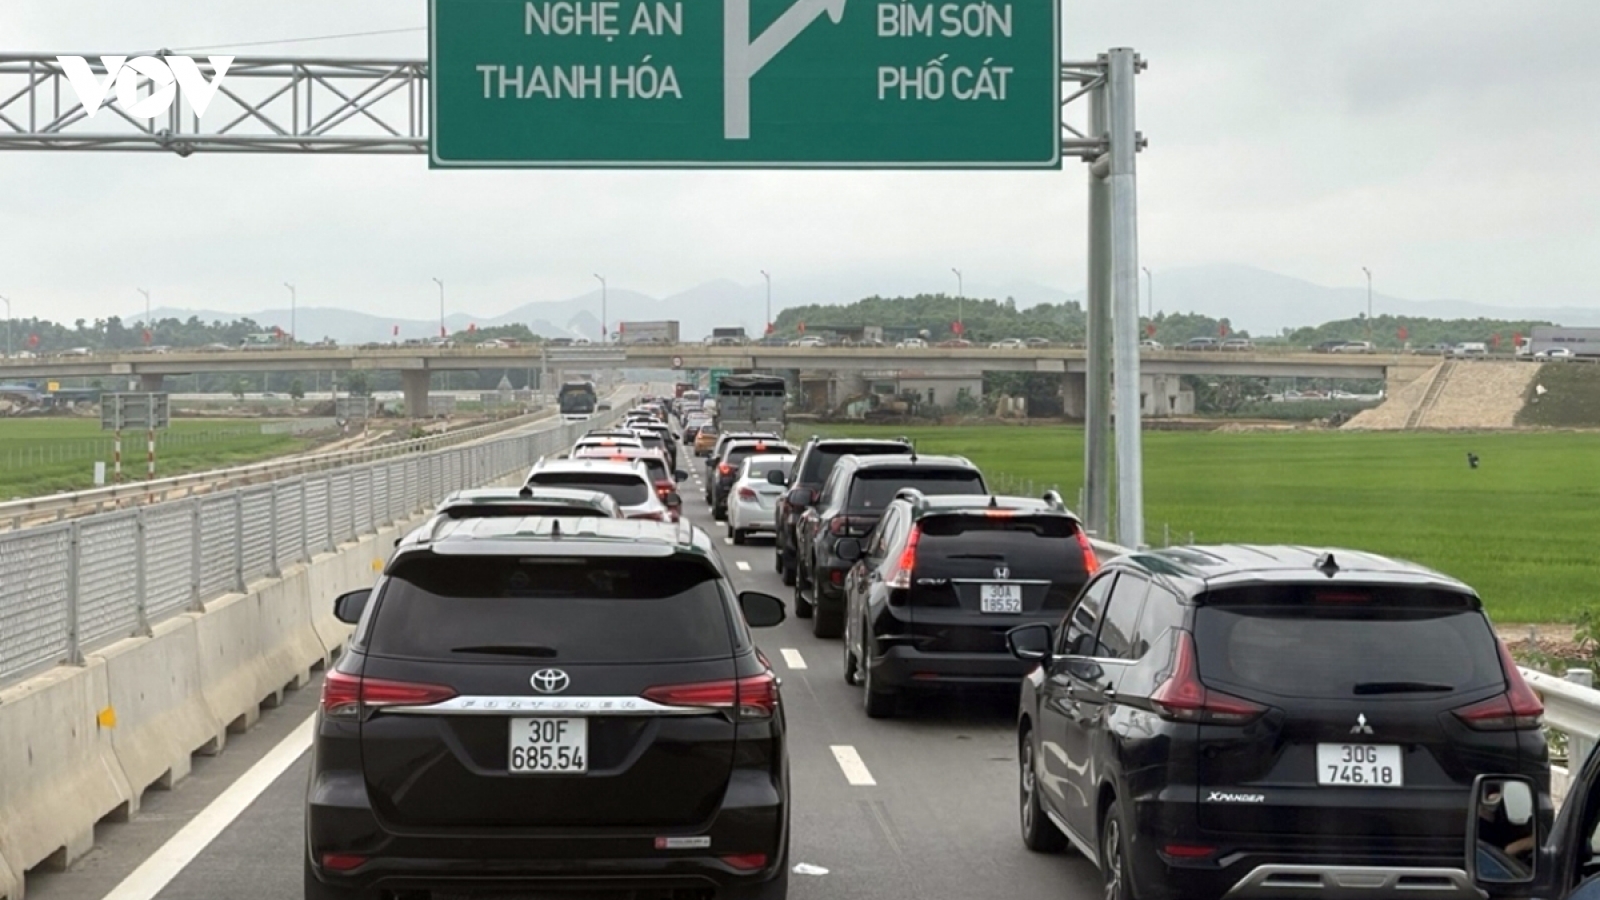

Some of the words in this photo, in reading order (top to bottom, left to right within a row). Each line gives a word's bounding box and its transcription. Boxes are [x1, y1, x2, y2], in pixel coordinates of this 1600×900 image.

[629, 1, 683, 35] AN
[939, 1, 1013, 37] SƠN
[476, 65, 601, 99] THANH
[610, 54, 683, 99] HÓA
[878, 53, 949, 100] PHỐ
[951, 57, 1014, 100] CÁT
[989, 585, 1013, 598] 30A
[528, 720, 569, 744] 30F
[511, 746, 584, 770] 685.54
[1341, 745, 1377, 764] 30G
[1327, 765, 1393, 784] 746.18
